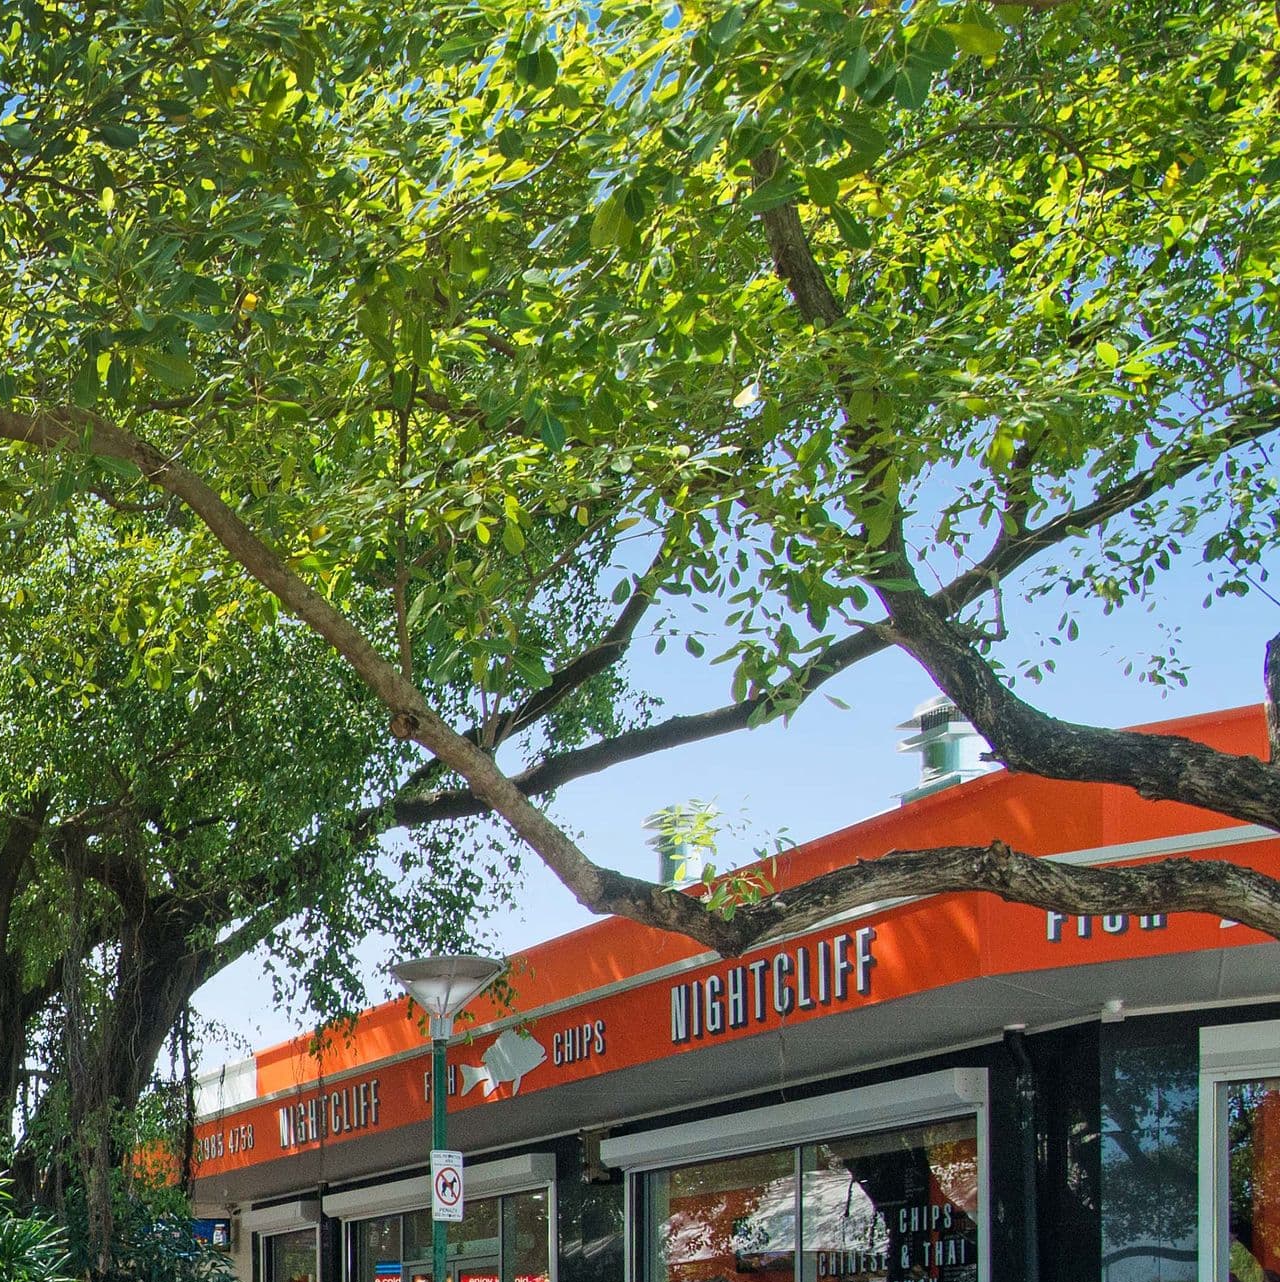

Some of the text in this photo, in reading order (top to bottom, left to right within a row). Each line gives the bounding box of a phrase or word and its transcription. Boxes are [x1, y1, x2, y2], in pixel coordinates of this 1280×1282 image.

[671, 927, 877, 1044] NIGHTCLIFF
[424, 1020, 606, 1102] FH CHIPS
[228, 1124, 255, 1154] 4758
[279, 1079, 380, 1149] NIGHTCLIFF
[899, 1203, 952, 1233] CHIPS
[819, 1251, 888, 1276] CHINESE
[923, 1239, 966, 1267] THAI
